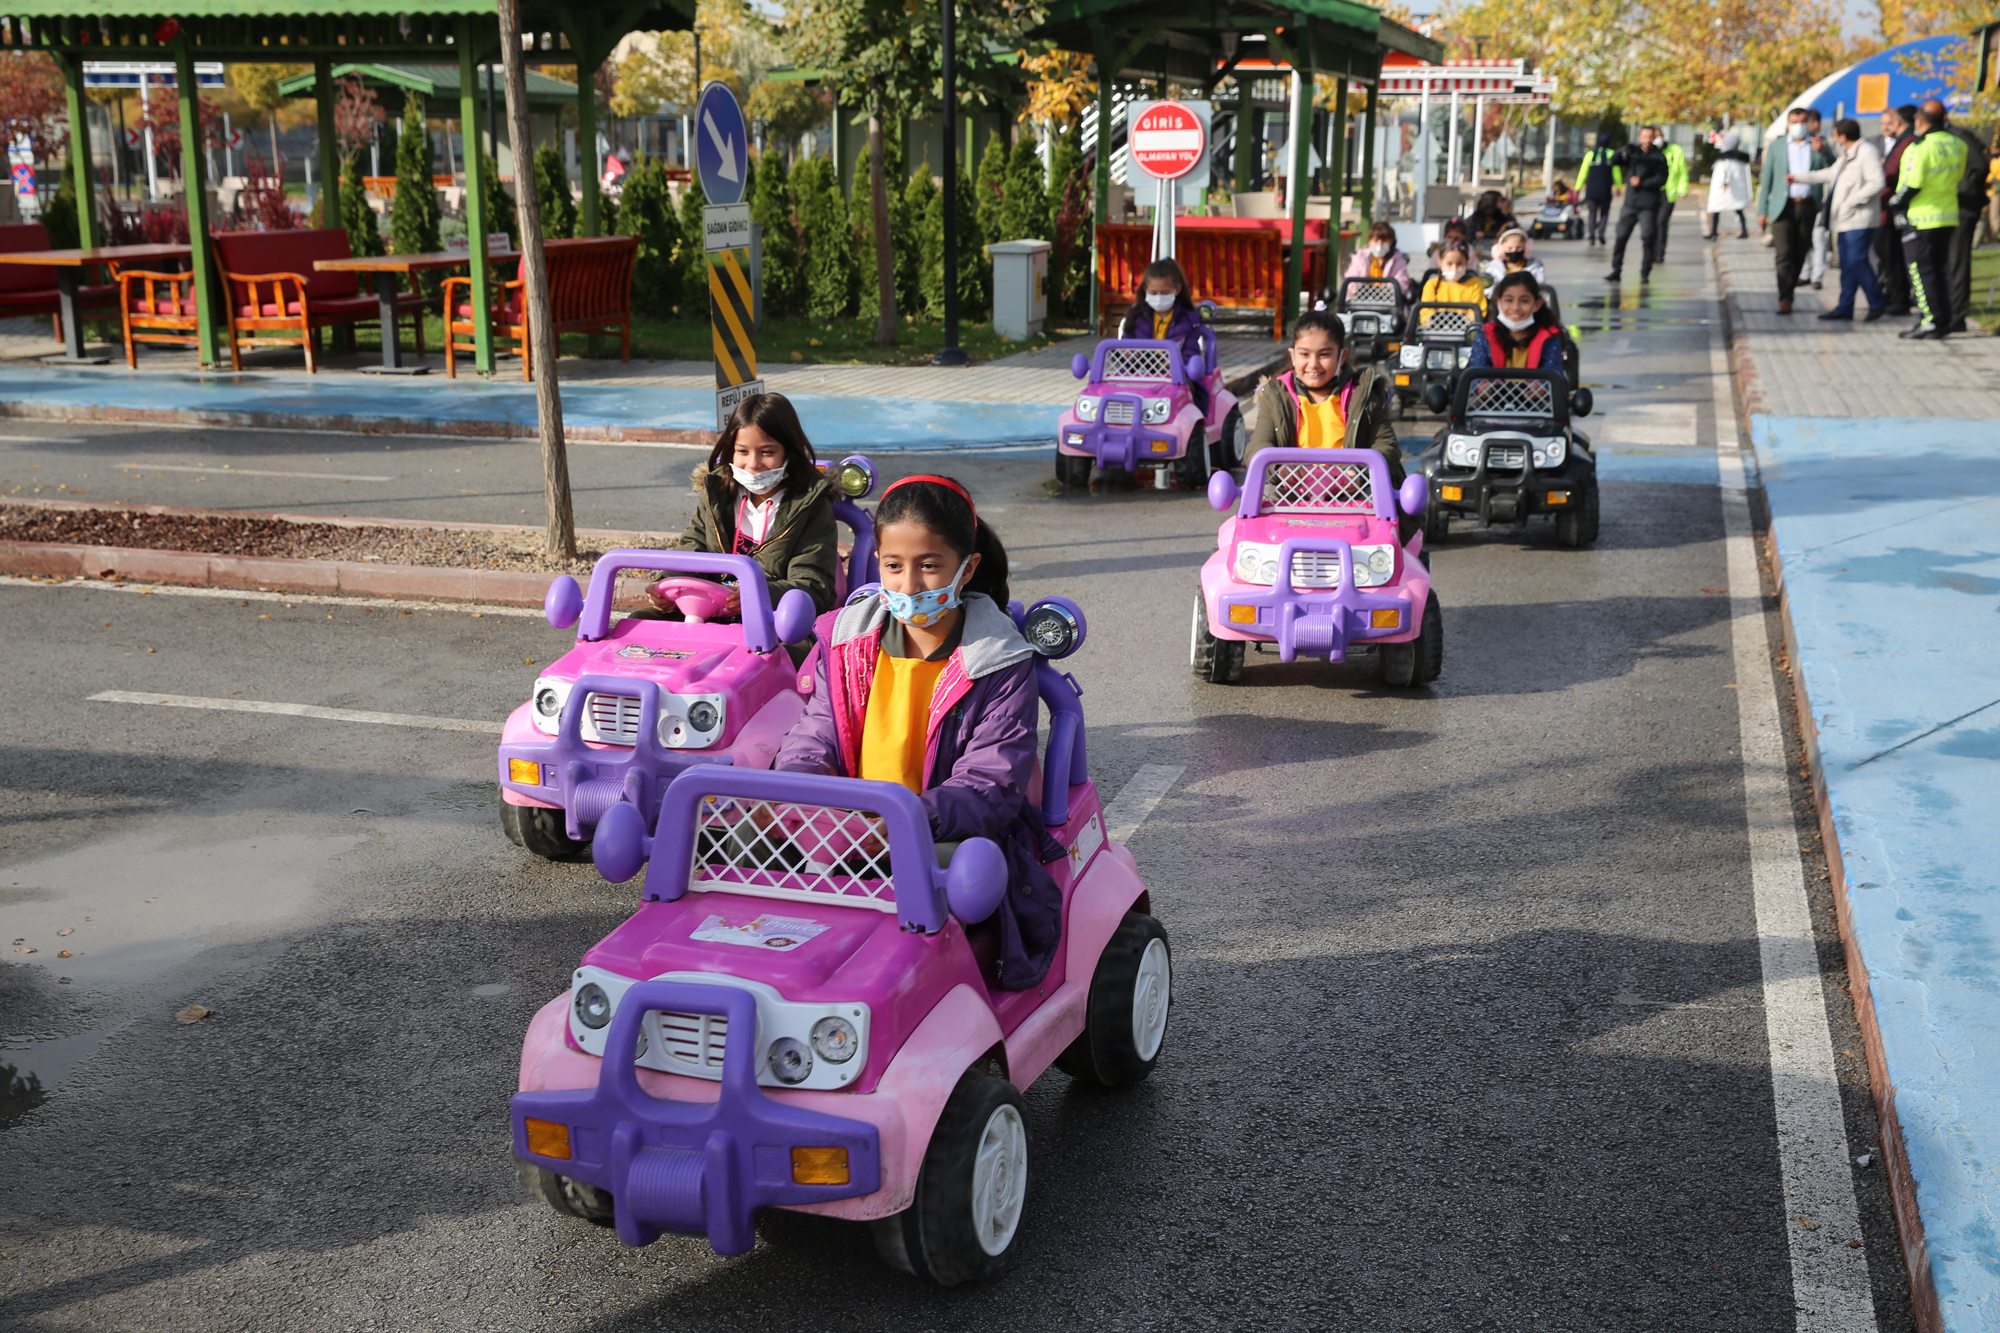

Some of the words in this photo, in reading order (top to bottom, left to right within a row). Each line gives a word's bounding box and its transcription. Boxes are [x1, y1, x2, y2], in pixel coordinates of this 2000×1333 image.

[1138, 152, 1177, 162] OLMAYAN
[1178, 151, 1194, 161] YOL
[707, 220, 727, 235] SAĞDAN
[722, 391, 740, 408] REFÜJ
